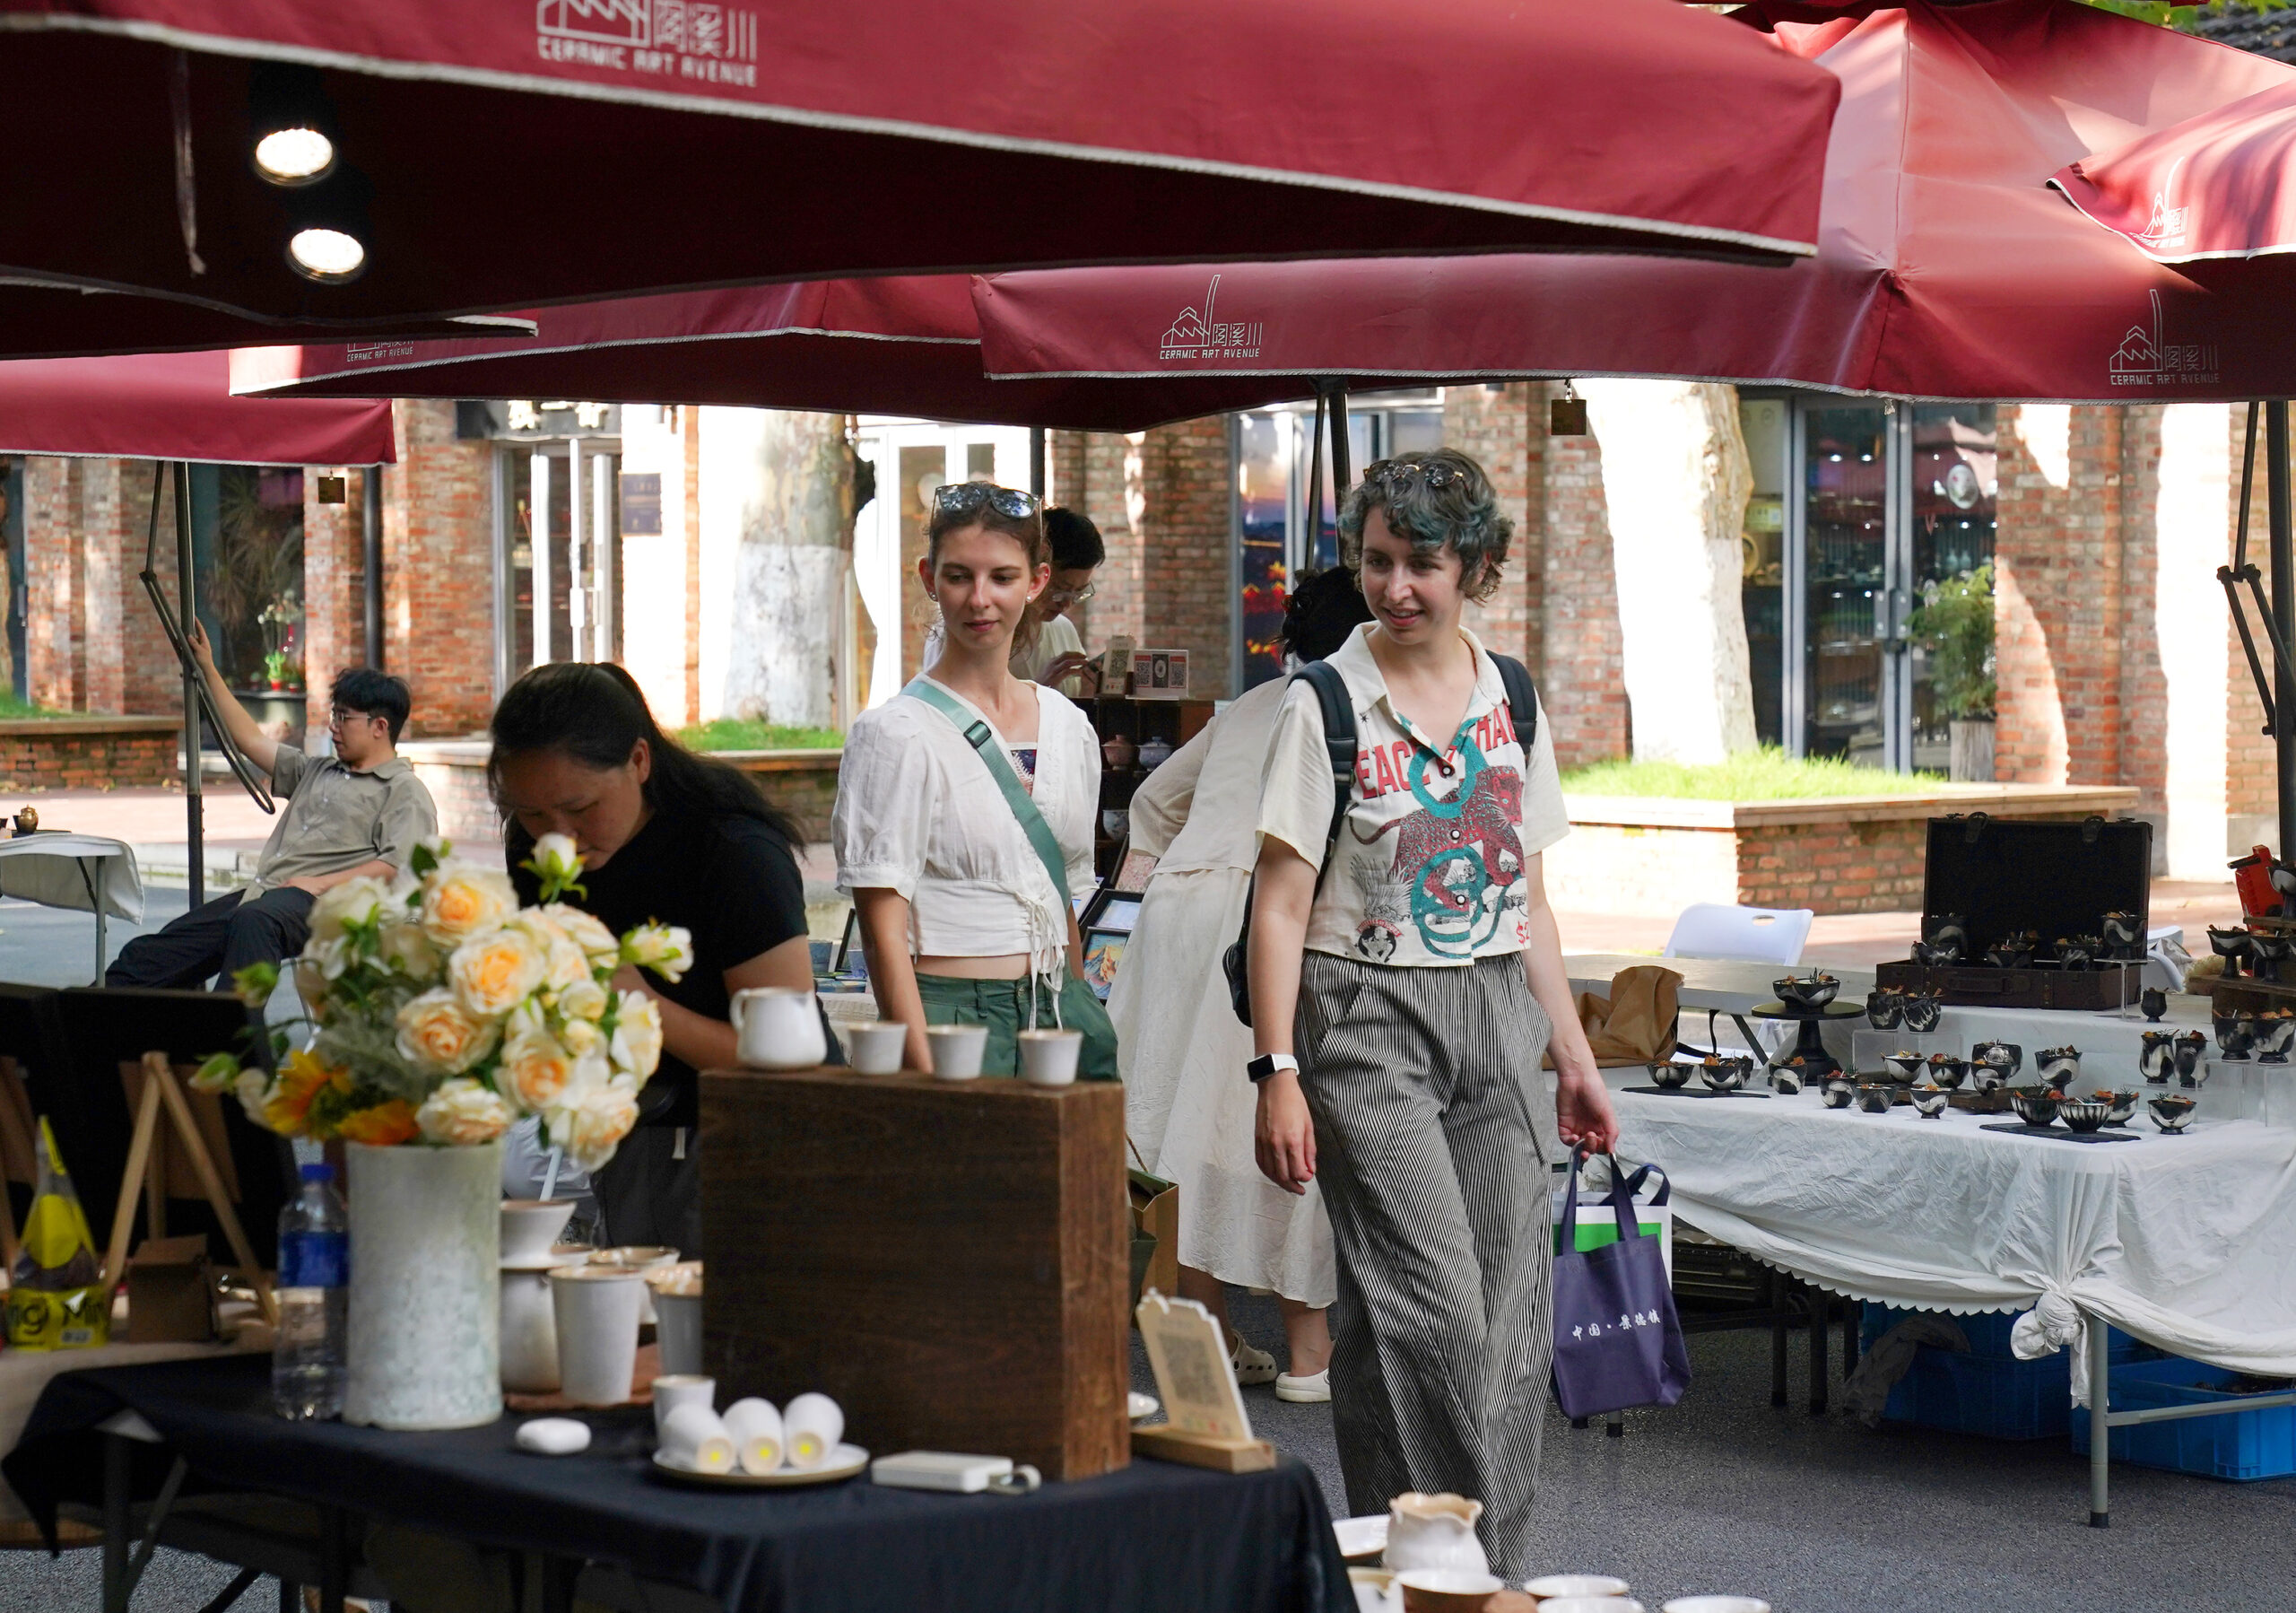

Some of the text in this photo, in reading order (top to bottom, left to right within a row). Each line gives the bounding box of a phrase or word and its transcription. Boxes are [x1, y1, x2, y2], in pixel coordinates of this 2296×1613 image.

[538, 36, 757, 87] CERAMIC ART AVENUE
[1212, 322, 1263, 347] 陶溪川
[346, 347, 413, 362] CERAMIC ART AVENUE
[1160, 347, 1260, 360] CERAMIC ART AVENUE
[2110, 372, 2221, 386] CERAMIC ART AVENUE
